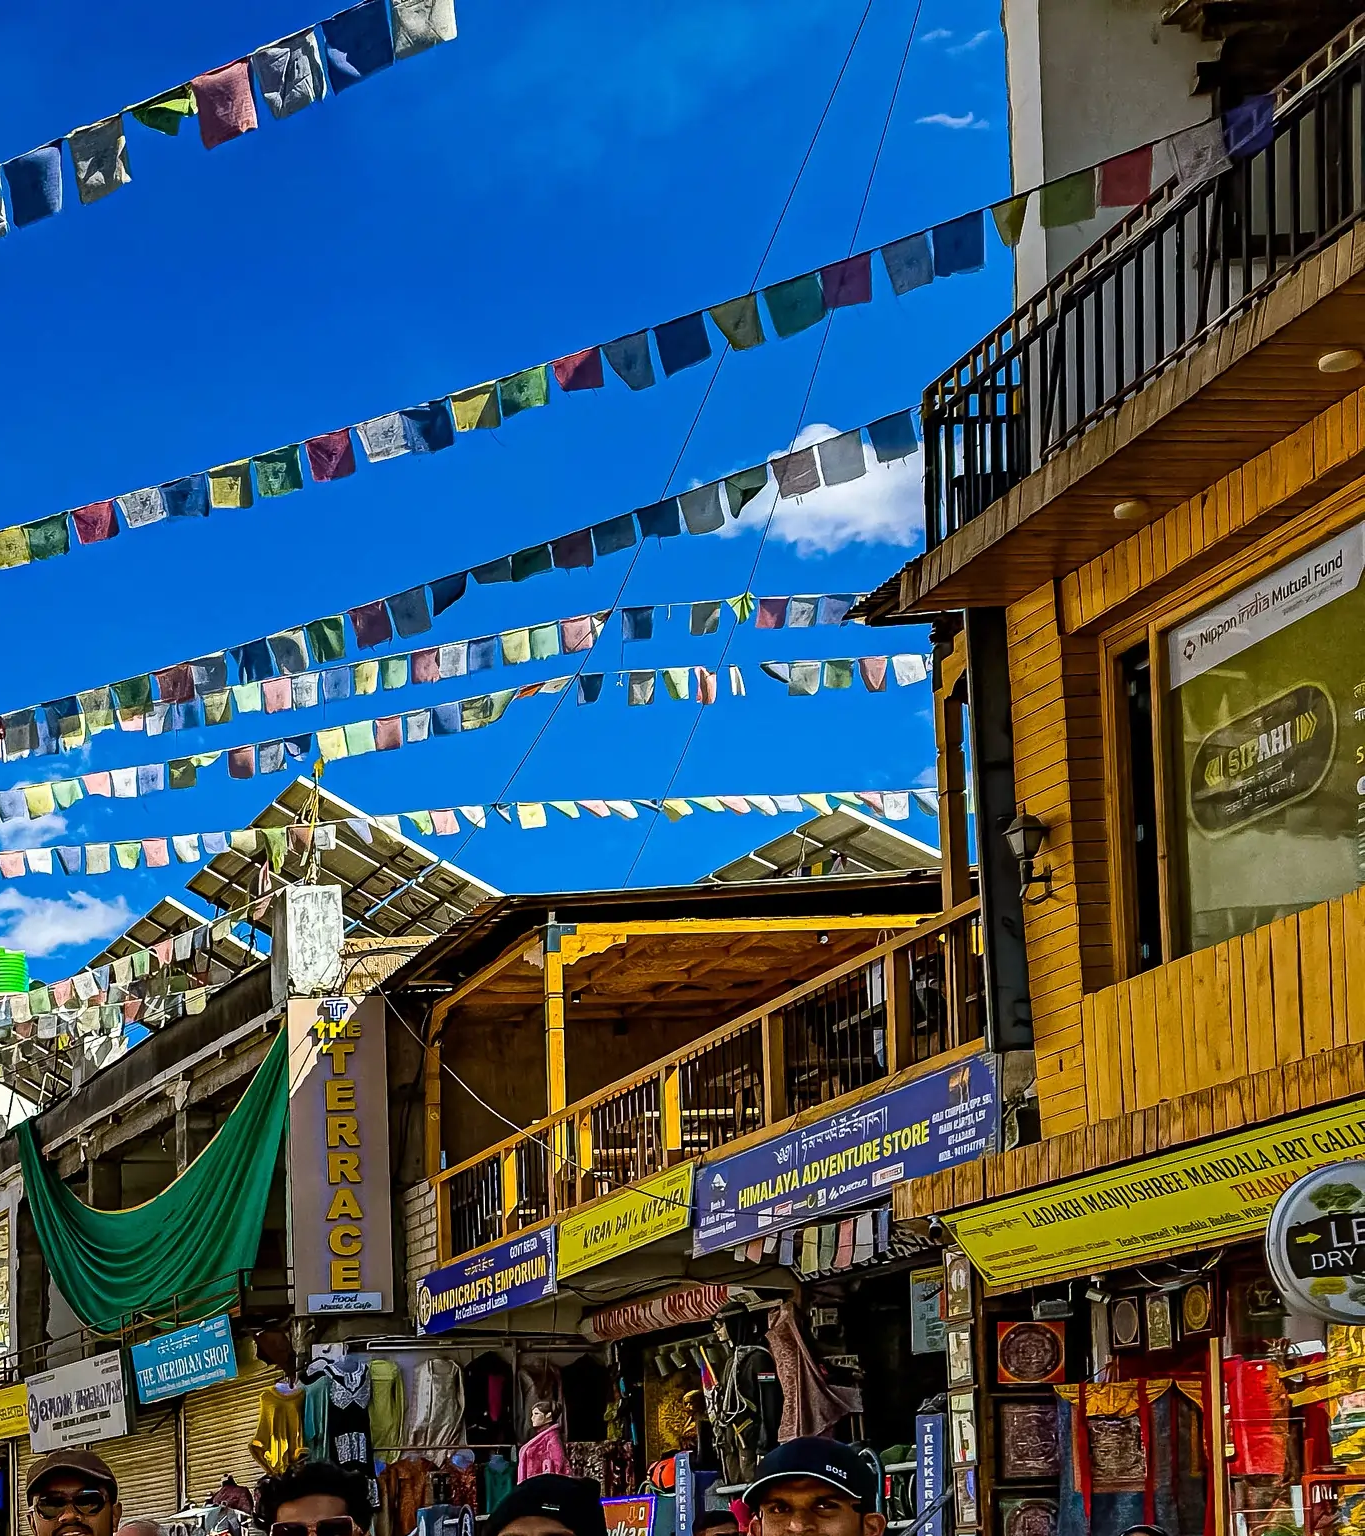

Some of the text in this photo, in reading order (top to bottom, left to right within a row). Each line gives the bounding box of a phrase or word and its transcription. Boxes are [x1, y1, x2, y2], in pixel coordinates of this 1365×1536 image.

[1199, 616, 1237, 648] Nippon
[1271, 568, 1312, 606] Mutual
[1314, 549, 1343, 582] Fund
[1228, 721, 1292, 777] SIPAHI
[325, 1042, 364, 1291] TERRACE
[738, 1167, 800, 1210] HIMALAYA
[802, 1142, 880, 1187] ADVENTURE
[882, 1120, 930, 1158] STORE
[1022, 1197, 1088, 1229] LADAKH
[1081, 1171, 1188, 1211] MANJUSHREE
[1187, 1148, 1274, 1189] MANDALA
[1272, 1136, 1313, 1165] ART
[1230, 1168, 1300, 1203] THANKA
[583, 1219, 614, 1249] KIRAN
[640, 1187, 686, 1225] KITCHEN
[1116, 1235, 1141, 1248] Teach
[1243, 1204, 1268, 1221] White
[432, 1275, 492, 1315] HANDICRAFTS
[495, 1255, 547, 1294] EMPORIUM
[1311, 1247, 1358, 1271] DRY
[331, 1294, 357, 1304] Food
[138, 1368, 155, 1389] THE
[156, 1352, 202, 1383] MERIDIAN
[204, 1344, 230, 1369] SHOP
[678, 1459, 687, 1531] TREKKERS
[825, 1464, 848, 1481] BOSS
